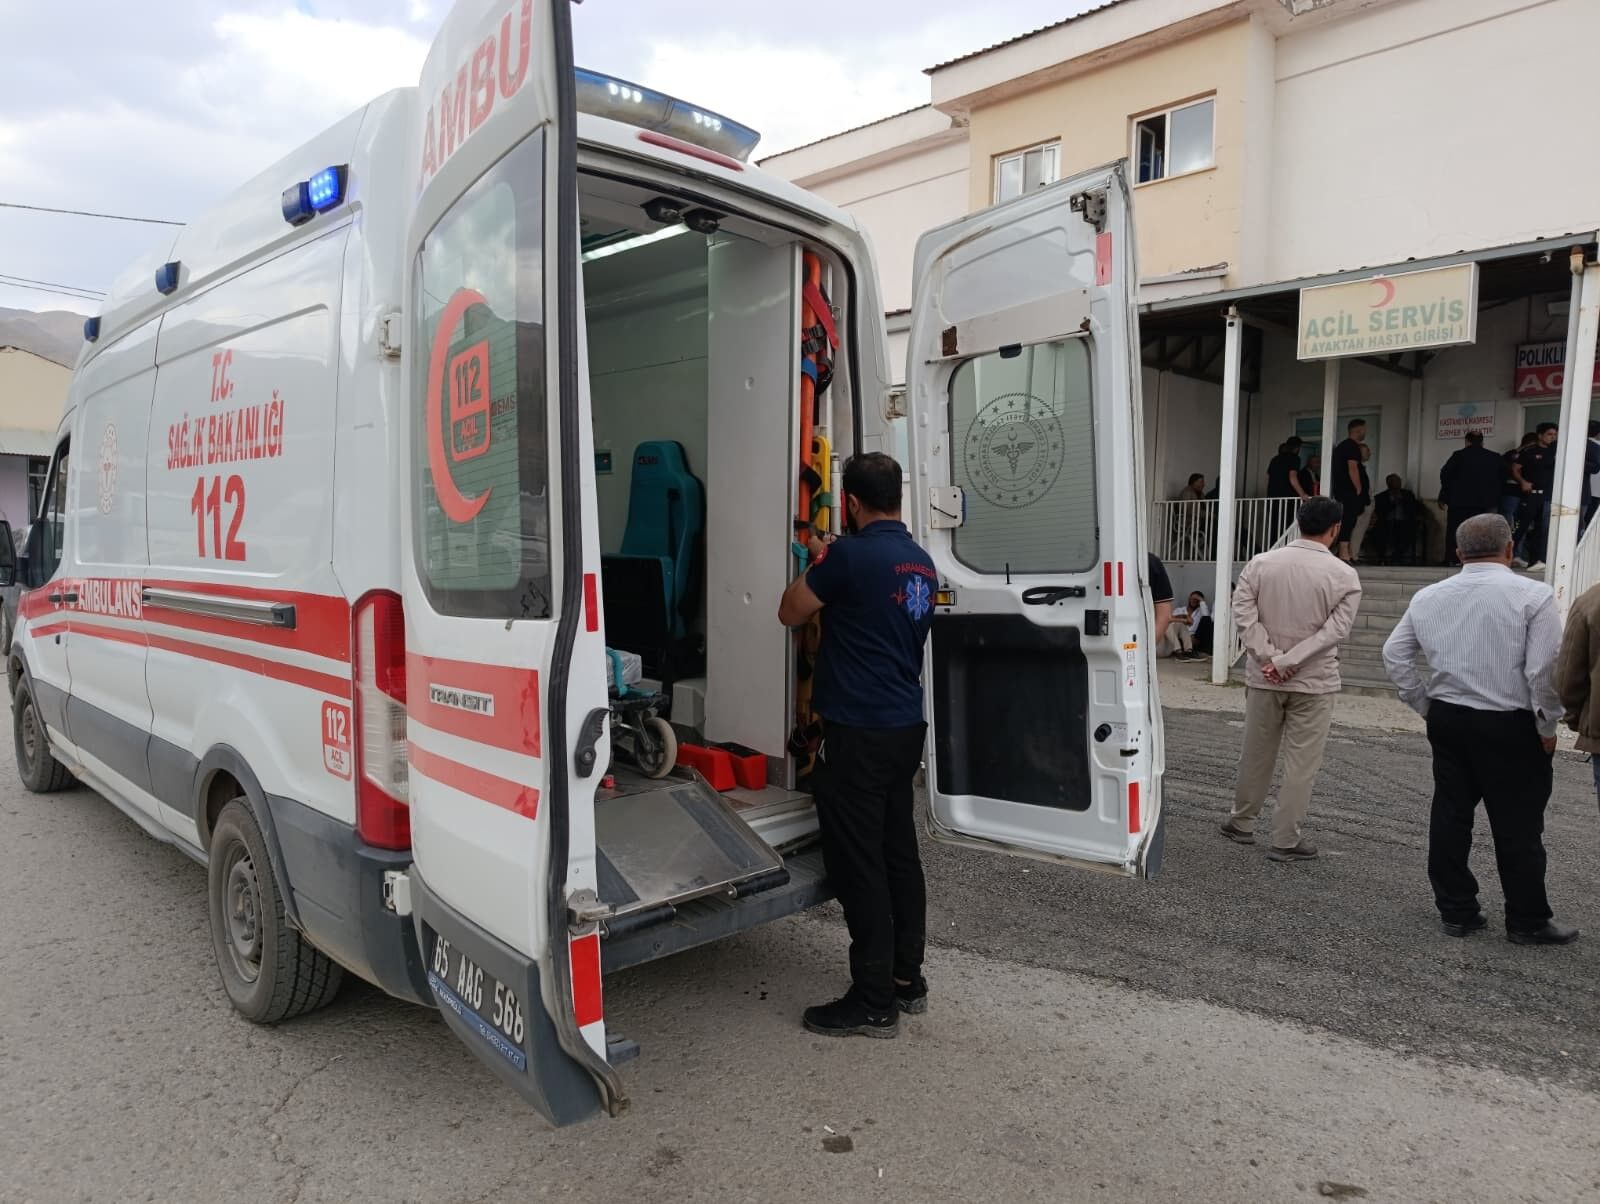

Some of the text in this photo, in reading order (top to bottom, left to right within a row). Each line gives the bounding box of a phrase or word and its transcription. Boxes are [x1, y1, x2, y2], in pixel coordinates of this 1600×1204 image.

[419, 0, 534, 193] AMBU
[1305, 297, 1464, 339] ACİL SERVİS
[1368, 333, 1409, 347] HASTA
[211, 349, 234, 402] T.C.
[456, 355, 482, 408] 112
[167, 389, 284, 471] SAĞLIK BAKANLIĞI
[192, 474, 246, 561] 112
[79, 579, 141, 619] AMBULANS
[326, 707, 347, 744] 112
[434, 934, 450, 979] 65
[457, 953, 484, 1010] AAG
